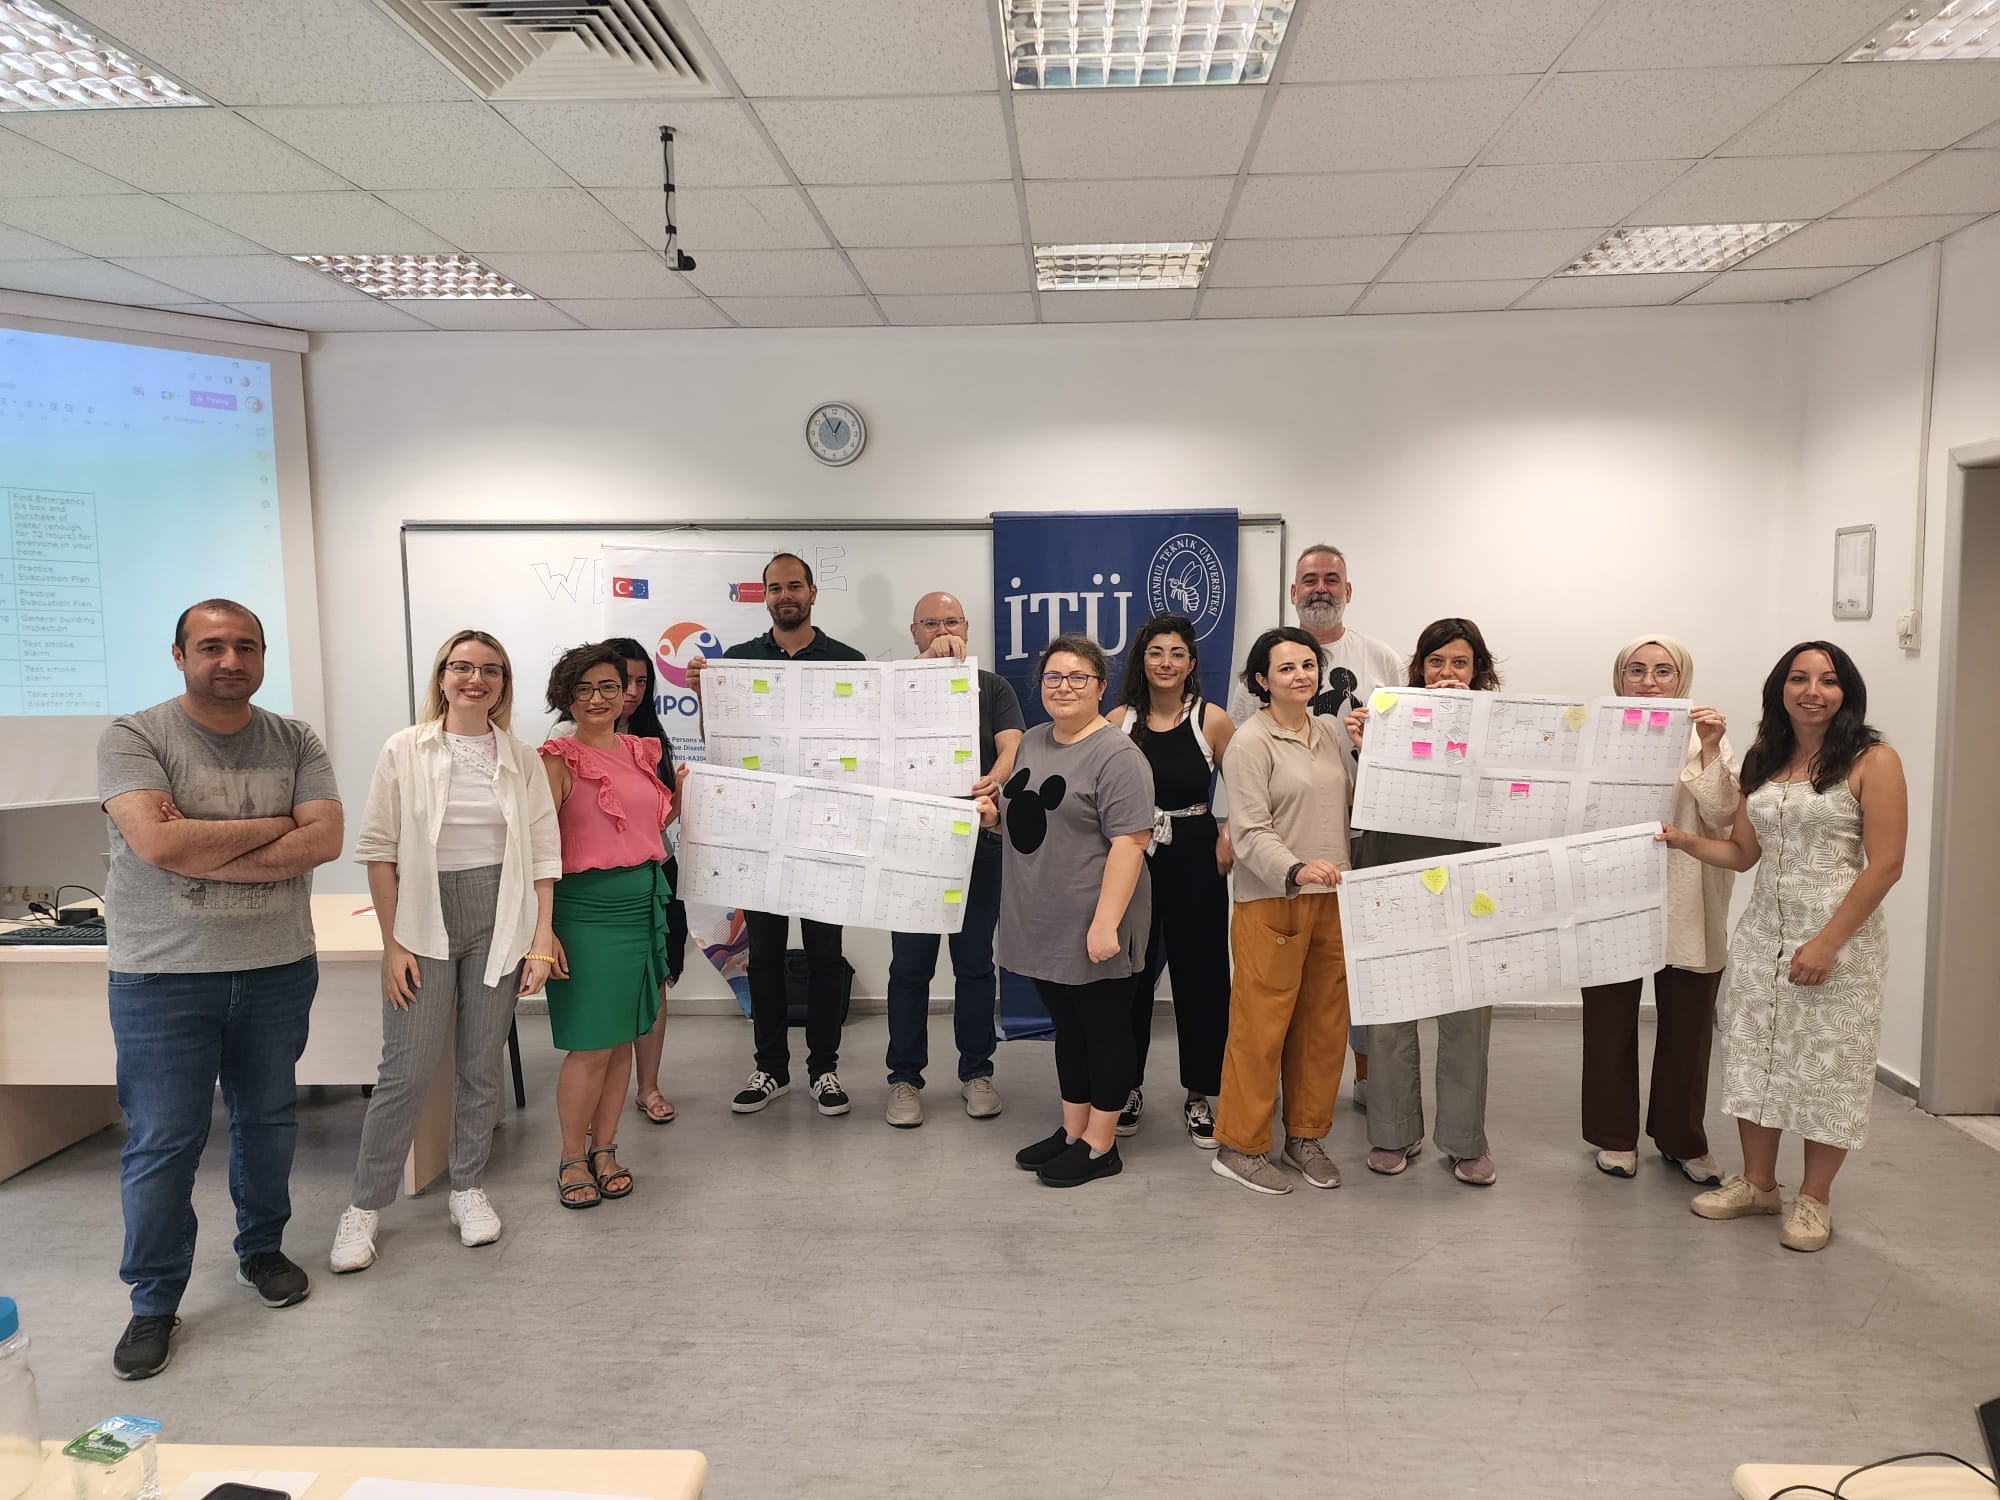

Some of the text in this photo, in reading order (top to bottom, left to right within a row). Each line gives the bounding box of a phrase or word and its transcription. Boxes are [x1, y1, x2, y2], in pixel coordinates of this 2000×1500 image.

[36, 495, 86, 506] Emergency
[72, 544, 93, 552] your
[18, 564, 54, 573] Practice
[18, 573, 91, 584] Evacuation Plan
[1159, 538, 1198, 562] TEKNİK
[1199, 546, 1221, 617] ÜNİVERSİTESİ
[20, 588, 56, 598] Practice
[20, 598, 93, 608] Evacuation Plan
[59, 616, 95, 625] building
[1003, 573, 1133, 661] İTÜ
[22, 640, 44, 648] Test
[24, 665, 44, 673] Test
